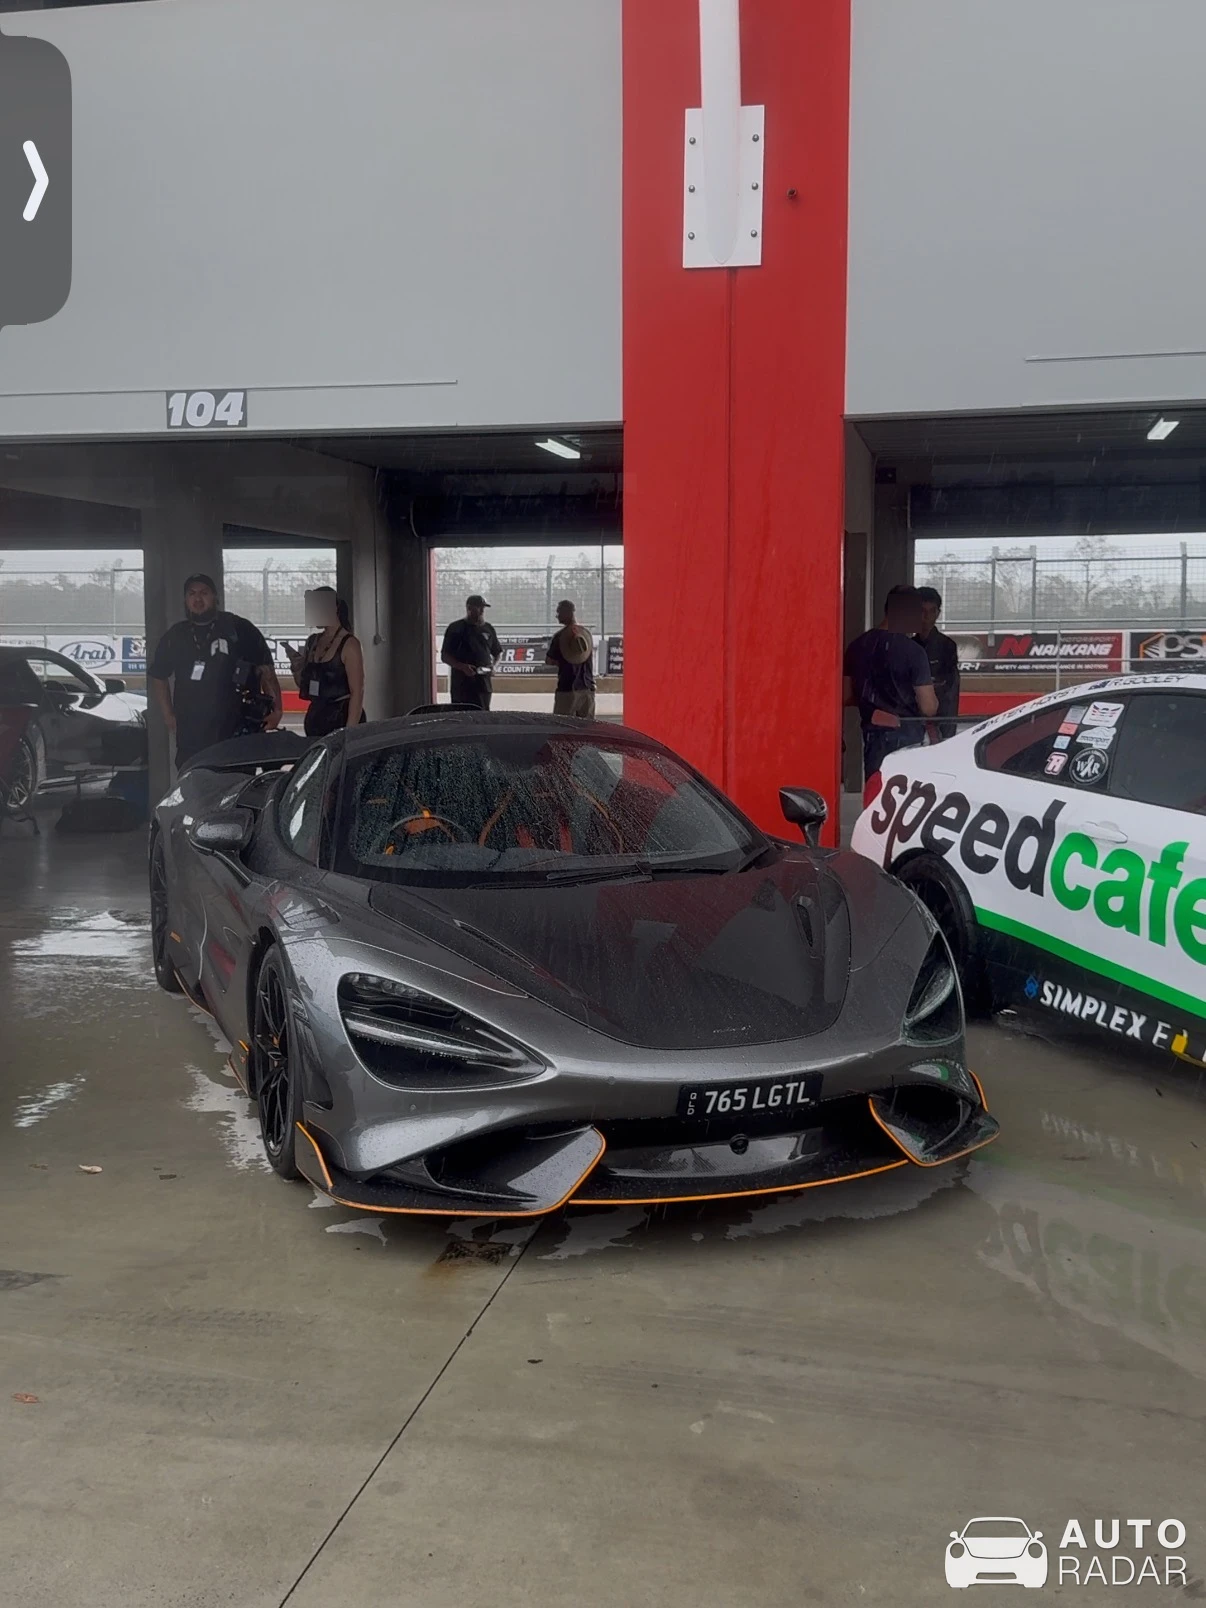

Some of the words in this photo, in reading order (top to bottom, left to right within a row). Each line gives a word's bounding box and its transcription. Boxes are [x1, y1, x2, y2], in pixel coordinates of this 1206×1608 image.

[168, 391, 244, 427] 104
[69, 643, 109, 661] Arai
[1040, 980, 1147, 1041] SIMPLEX
[687, 1092, 697, 1116] QLD
[705, 1088, 748, 1114] 765
[752, 1081, 810, 1109] LGTL
